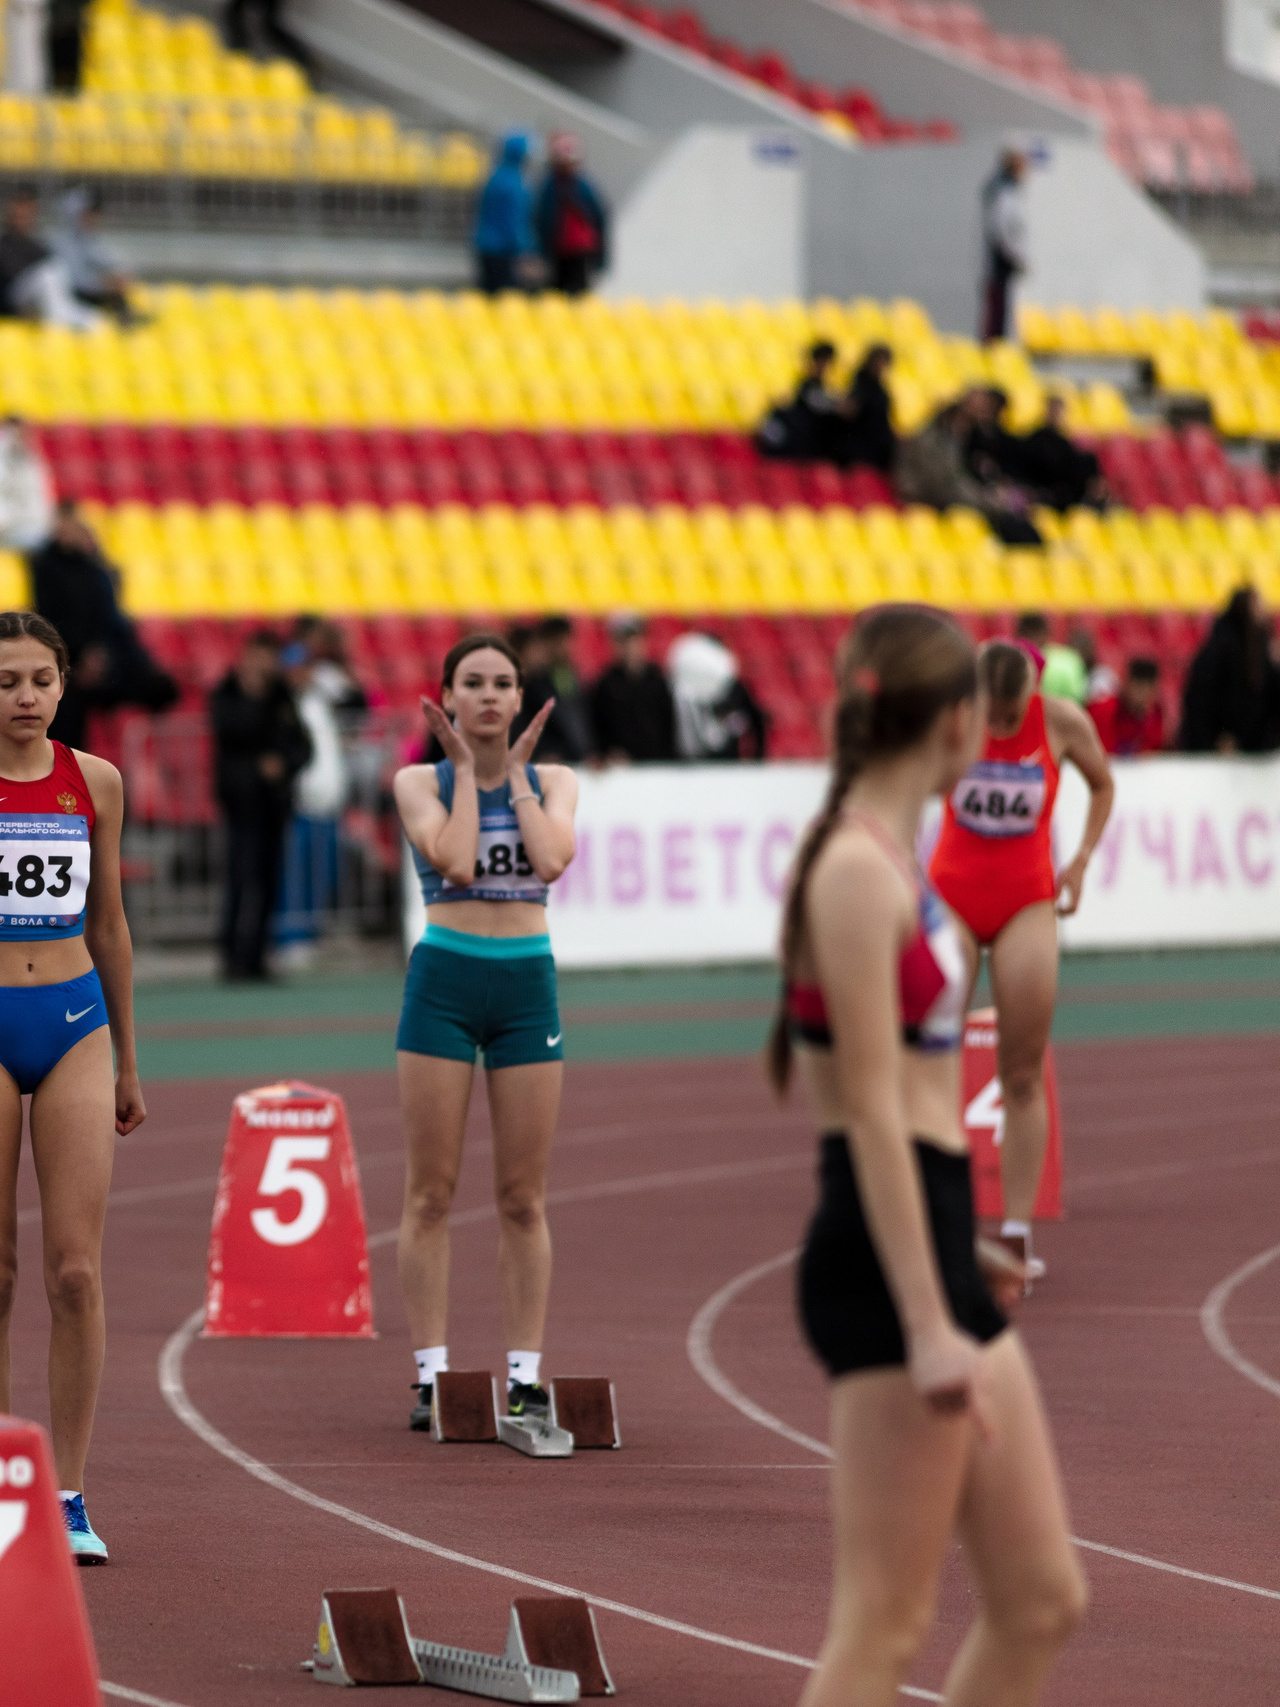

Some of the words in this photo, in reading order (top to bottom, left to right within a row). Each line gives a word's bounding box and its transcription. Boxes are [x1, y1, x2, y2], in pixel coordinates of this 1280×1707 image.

[963, 787, 1029, 819] 484
[1096, 808, 1280, 889] УЧАС
[10, 917, 44, 926] ВФЛА
[964, 1076, 1006, 1145] 4
[250, 1136, 331, 1246] 5
